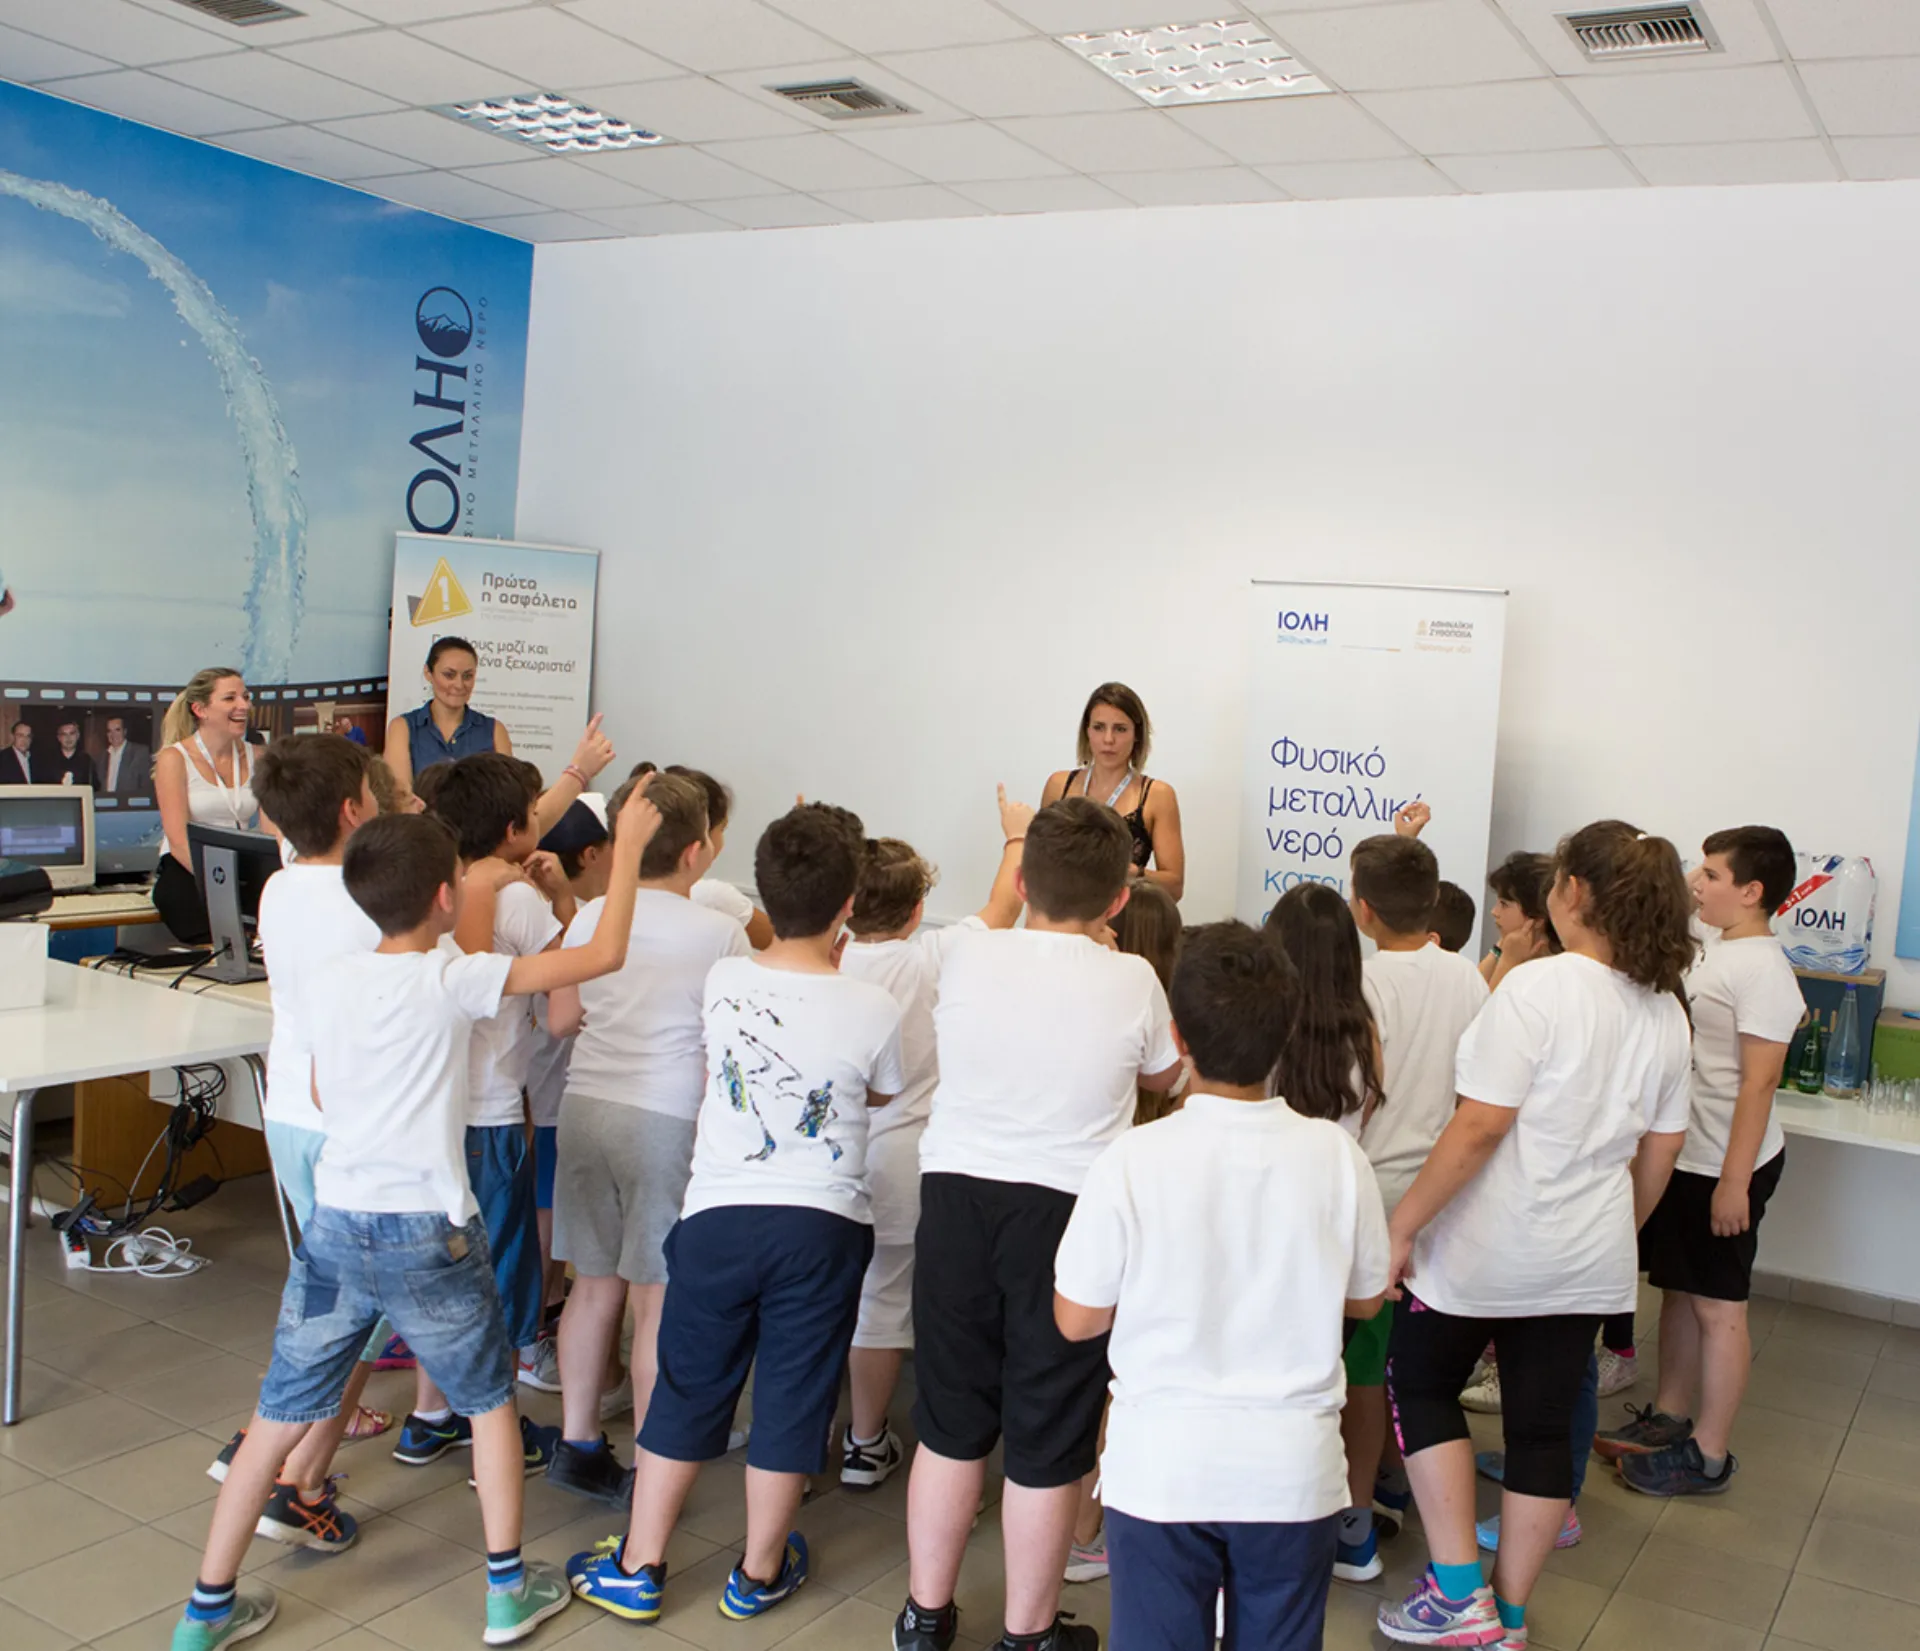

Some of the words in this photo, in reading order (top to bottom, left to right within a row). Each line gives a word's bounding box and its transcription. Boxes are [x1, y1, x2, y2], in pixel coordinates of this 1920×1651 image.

[476, 296, 489, 350] ΝΕΡΟ
[467, 363, 484, 479] ΜΕΤΑΛΛΙΚΟ
[406, 355, 468, 535] ΟΛΗ
[463, 493, 476, 537] ΣΙΚΟ
[482, 572, 537, 591] Πρώτα
[499, 592, 578, 609] ασφάλεια
[1278, 611, 1329, 631] ΙΟΛΗ
[467, 637, 494, 653] ους
[497, 640, 525, 655] μαζί
[527, 644, 549, 655] και
[477, 653, 501, 668] ένα
[505, 655, 576, 673] ξεχωριστά!
[1271, 737, 1386, 778] Φυσικό
[1269, 785, 1422, 822] μεταλλικ
[1266, 828, 1343, 862] νερό
[1795, 907, 1846, 931] ΙΟΛΗ
